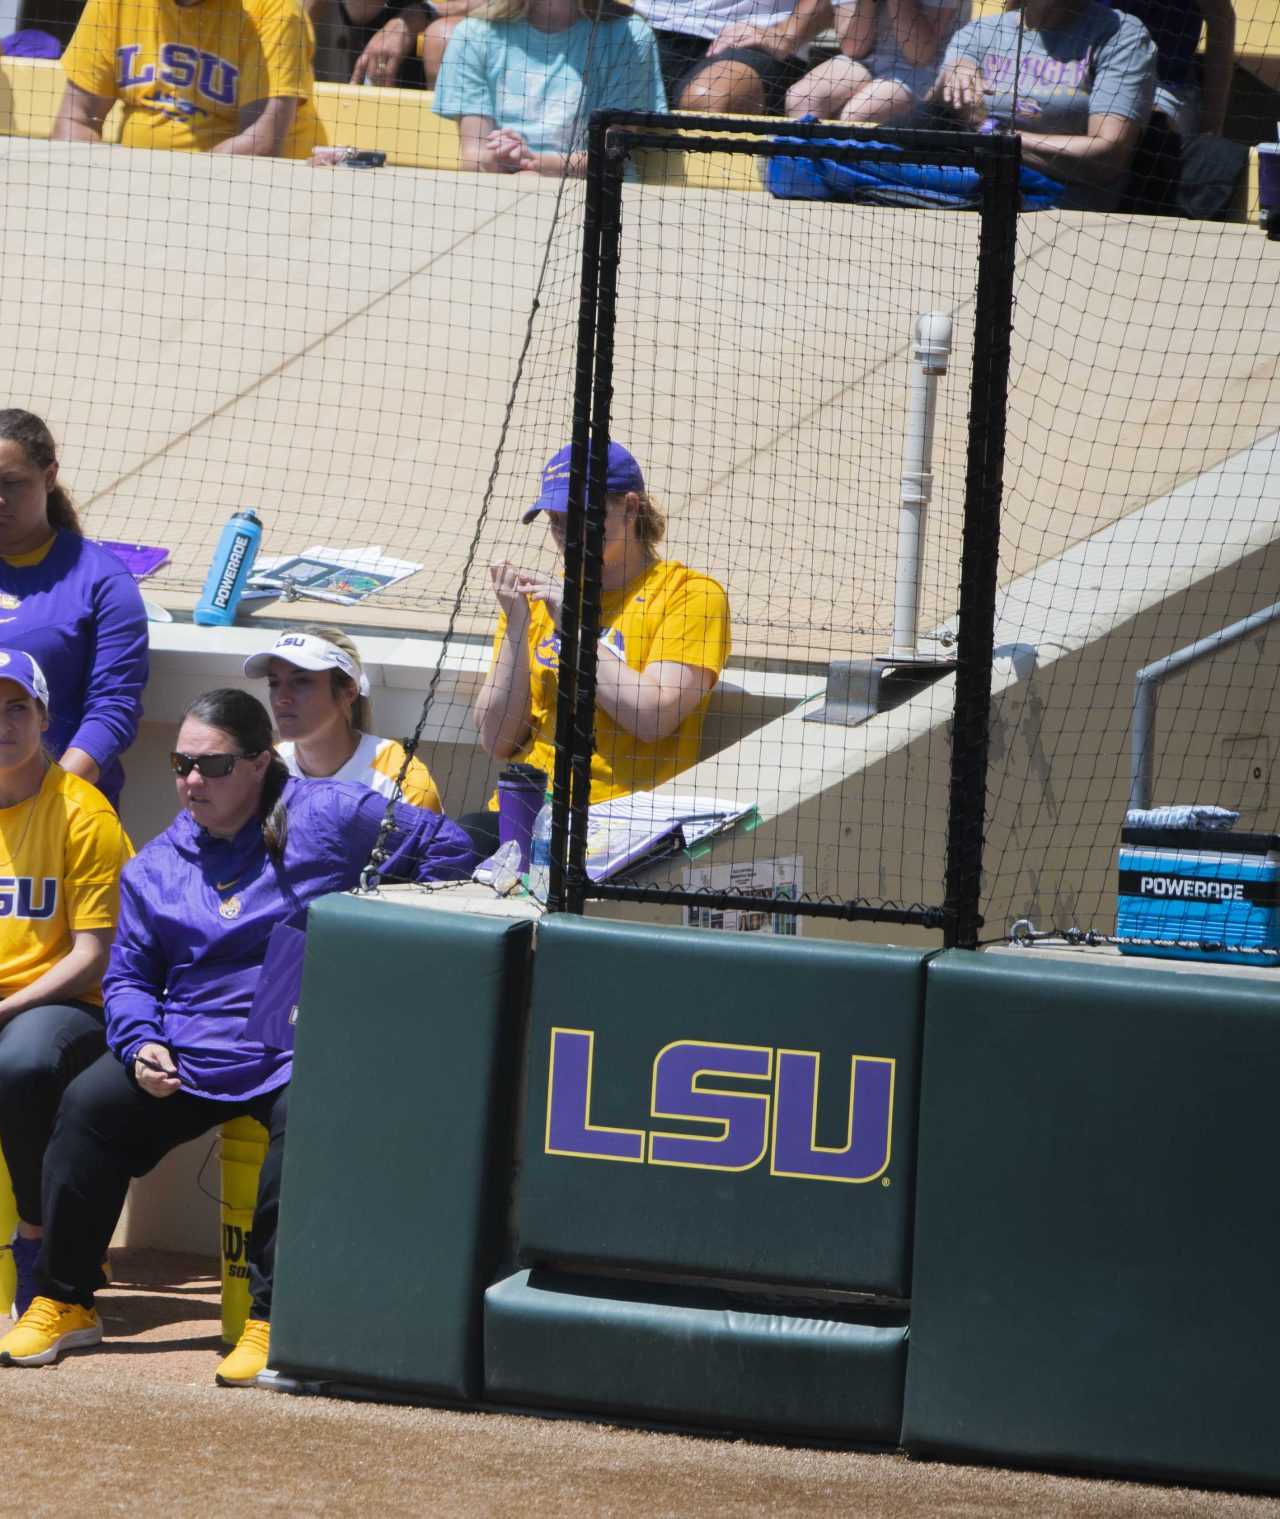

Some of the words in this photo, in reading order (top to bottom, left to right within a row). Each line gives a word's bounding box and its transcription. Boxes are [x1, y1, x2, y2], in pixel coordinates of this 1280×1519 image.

[116, 41, 240, 106] LSU
[213, 535, 250, 609] POWERADE
[275, 637, 306, 648] LSU
[1140, 876, 1245, 901] POWERADE
[544, 1026, 896, 1184] LSU
